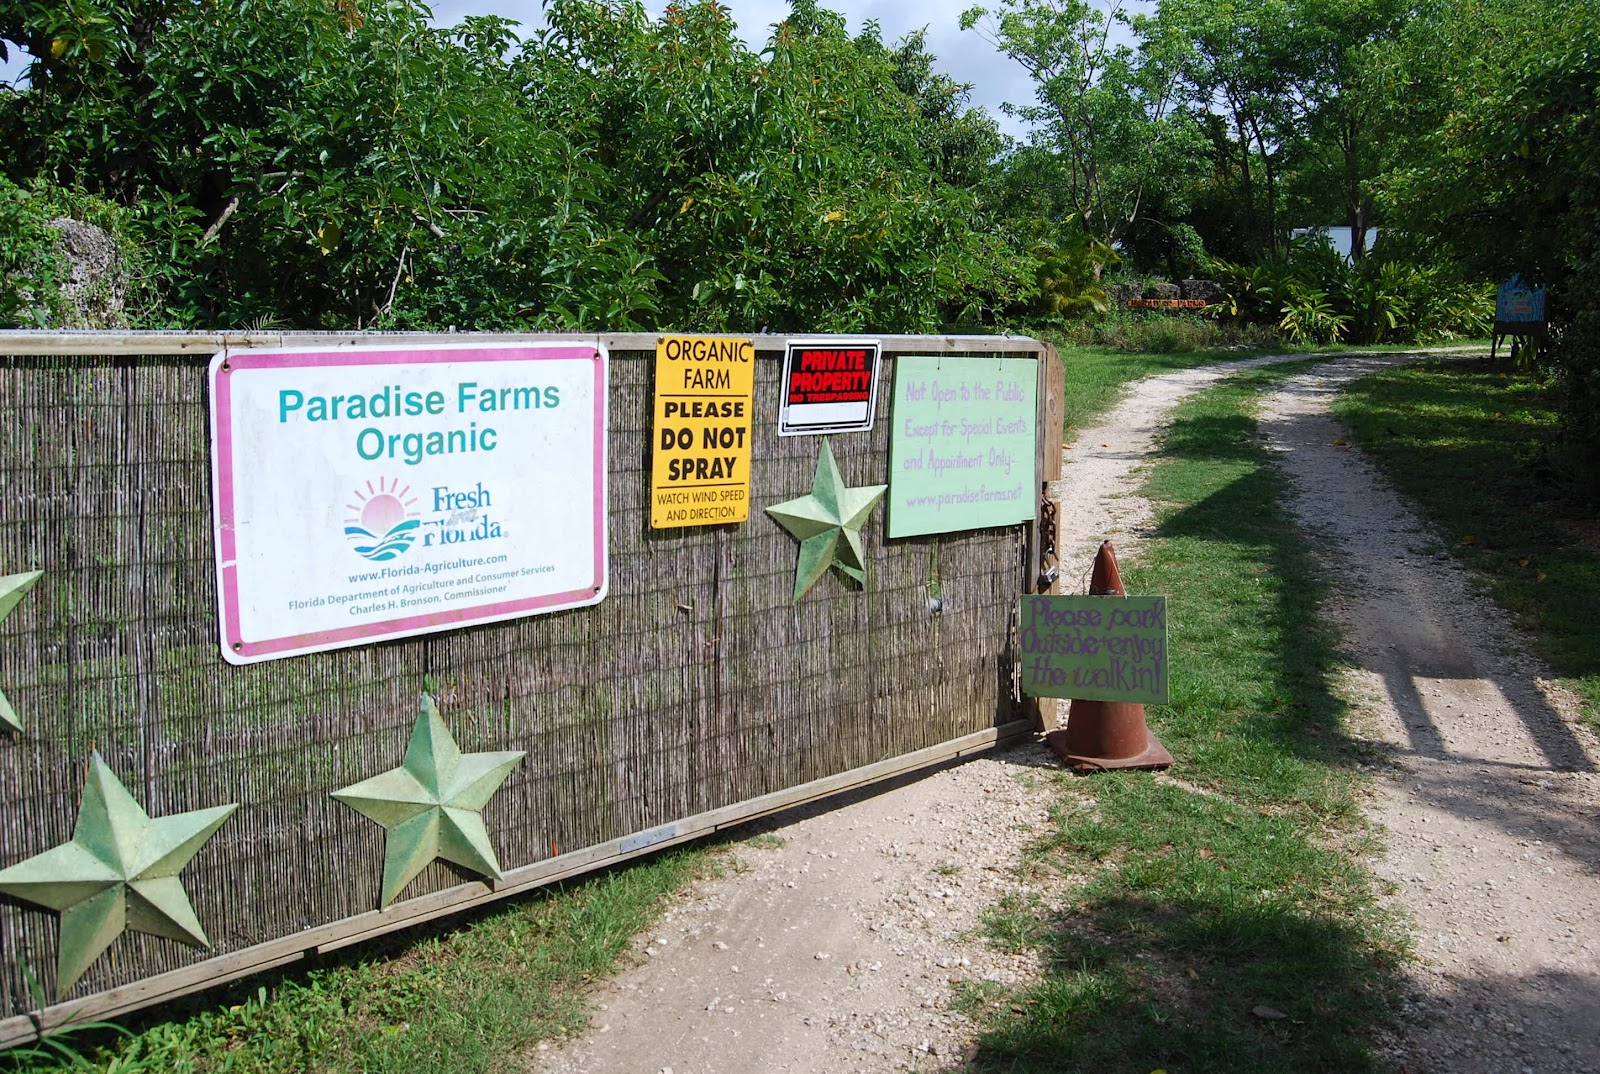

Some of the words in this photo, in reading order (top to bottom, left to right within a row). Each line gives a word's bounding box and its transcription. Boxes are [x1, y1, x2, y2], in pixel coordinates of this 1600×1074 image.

[666, 339, 750, 363] ORGANIC
[800, 350, 866, 371] PRIVATE
[683, 368, 731, 390] FARM
[790, 371, 872, 393] PROPERTY
[279, 385, 446, 424] Paradise
[458, 382, 561, 414] Farms
[664, 401, 745, 419] PLEASE
[789, 394, 805, 404] NO
[806, 391, 870, 403] TRESPASSING
[906, 380, 928, 401] Not
[931, 379, 957, 412] Open
[961, 383, 971, 401] to
[973, 381, 991, 401] the
[996, 380, 1025, 402] Public
[356, 422, 499, 466] Organic
[661, 428, 694, 451] DO
[703, 427, 747, 450] NOT
[904, 418, 939, 444] Except
[942, 419, 957, 436] for
[960, 417, 993, 444] Special
[996, 415, 1028, 436] Events
[668, 456, 738, 481] SPRAY
[903, 448, 924, 471] and
[928, 448, 984, 478] Appointment
[431, 482, 493, 512] Fresh
[657, 493, 690, 506] WATCH
[692, 491, 718, 504] WIND
[720, 489, 746, 502] SPEED
[666, 509, 688, 521] AND
[690, 506, 736, 520] DIRECTION
[348, 554, 508, 583] www.Florida-Agriculture.com
[288, 597, 326, 611] Florida
[327, 588, 389, 606] Department
[390, 585, 401, 596] of
[402, 579, 455, 595] Agriculture
[456, 575, 475, 586] and
[475, 569, 520, 583] Consumer
[521, 564, 556, 577] Services
[349, 602, 386, 616] Charles
[388, 599, 399, 610] H.
[400, 595, 442, 609] Bronson,
[444, 584, 508, 601] Commissioner
[1029, 597, 1102, 629] Please
[1106, 600, 1166, 632] park
[1022, 626, 1100, 657] Outside
[1026, 655, 1067, 687] the
[1072, 656, 1131, 691] walk
